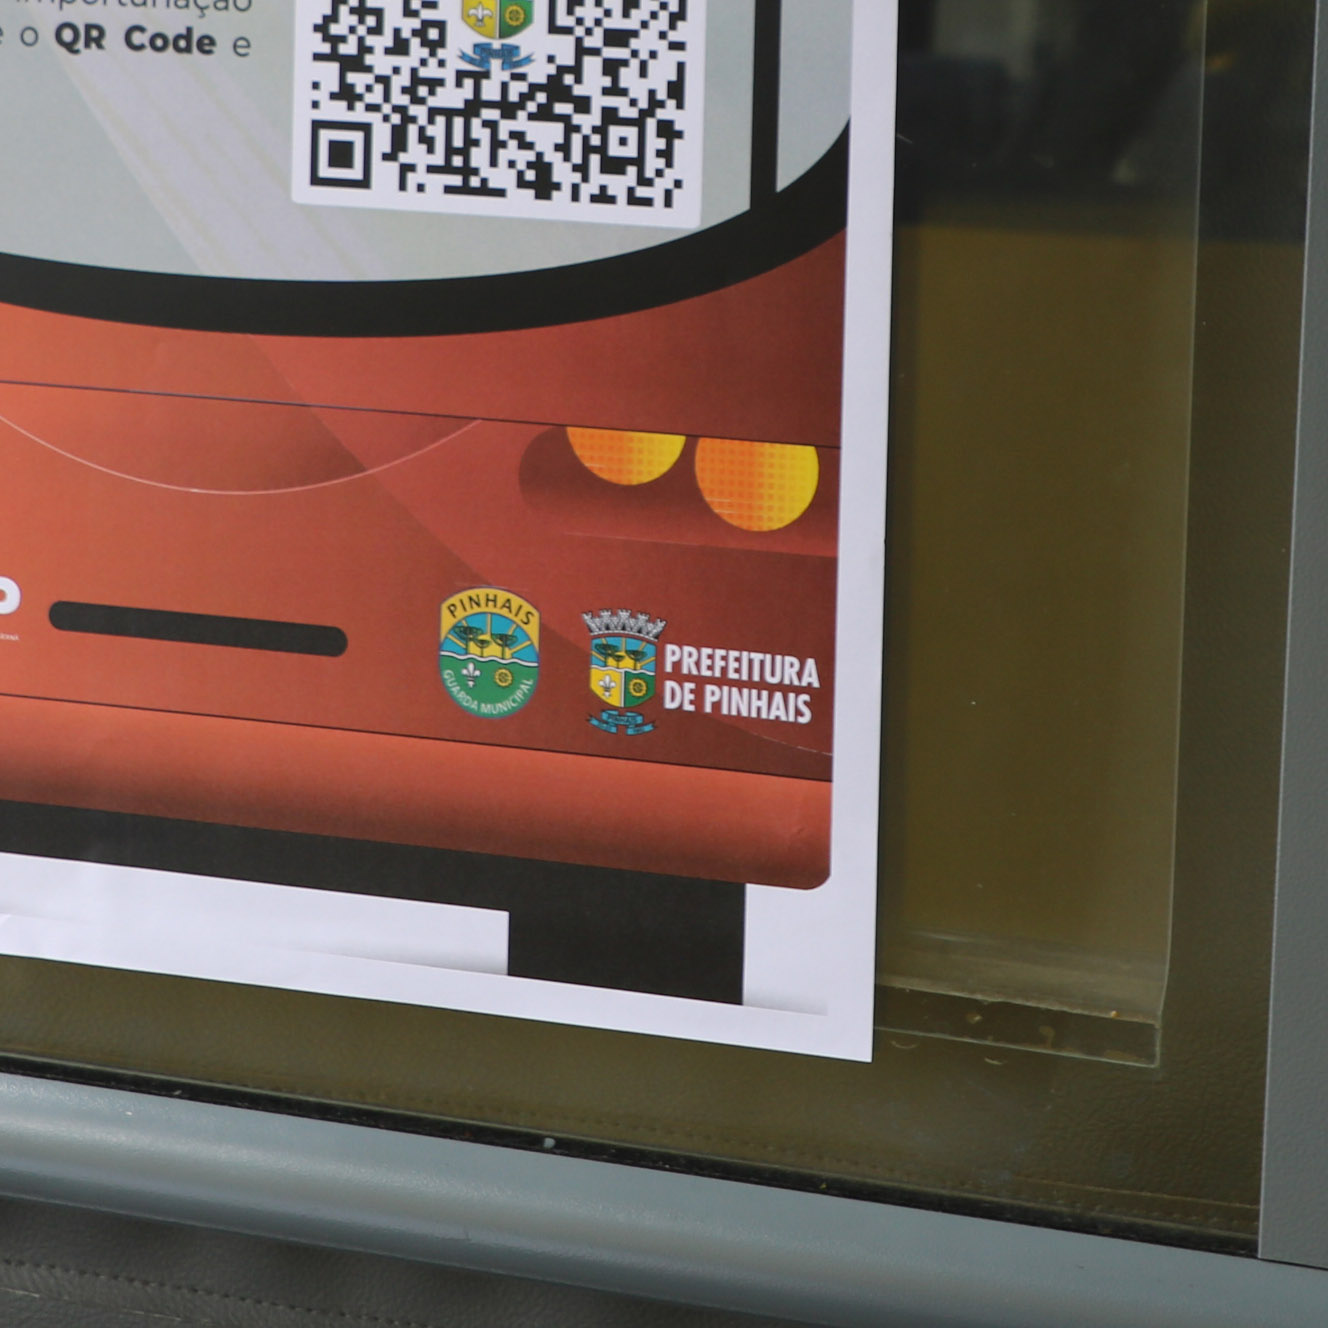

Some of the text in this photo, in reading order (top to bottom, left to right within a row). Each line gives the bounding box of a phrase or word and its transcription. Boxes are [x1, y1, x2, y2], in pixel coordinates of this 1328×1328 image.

[19, 26, 39, 47] o
[54, 22, 107, 54] QR
[123, 24, 217, 55] Code
[232, 36, 252, 58] e
[447, 592, 536, 626] PINHAIS
[664, 643, 821, 689] PREFEITURA
[443, 669, 534, 715] GUARDA MUNICIPAL
[664, 680, 813, 725] DE PINHAIS
